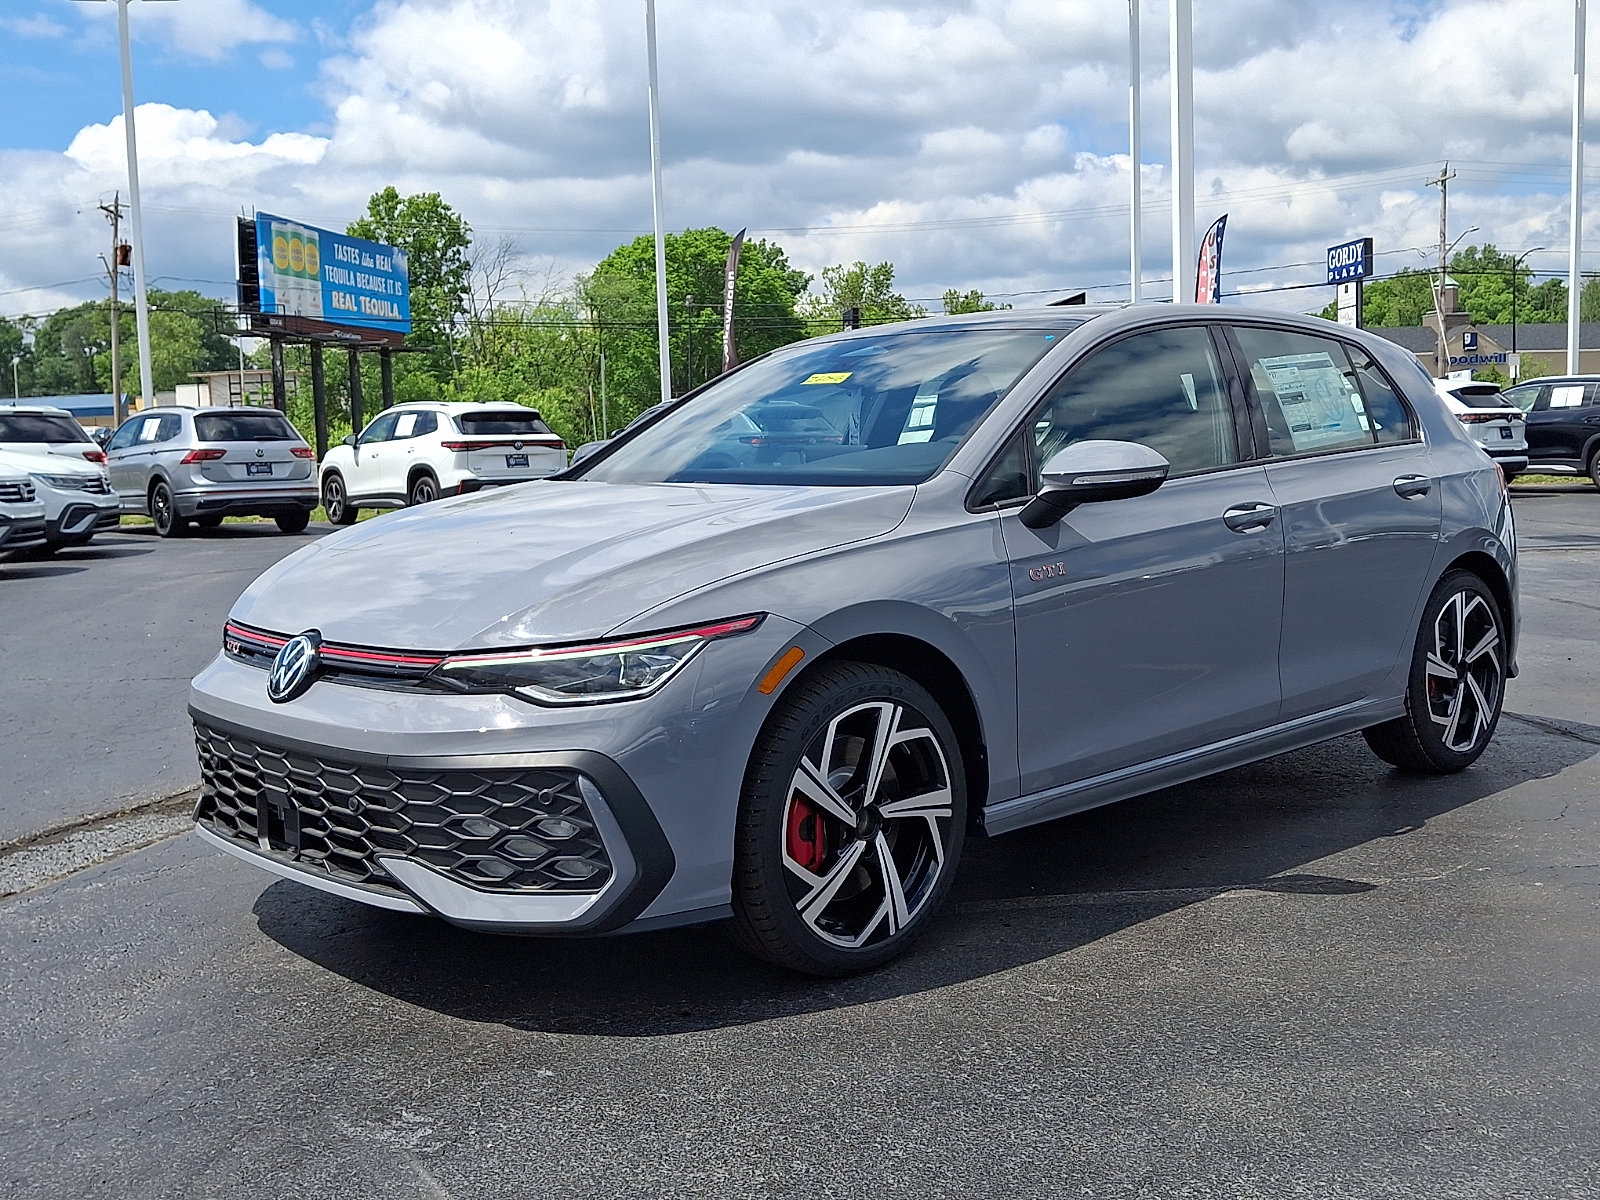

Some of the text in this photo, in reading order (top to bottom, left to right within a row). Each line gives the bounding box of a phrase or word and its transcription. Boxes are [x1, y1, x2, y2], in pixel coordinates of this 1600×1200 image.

[334, 243, 360, 265] TASTES
[361, 252, 375, 268] like
[376, 254, 392, 272] REAL
[1328, 242, 1364, 269] GORDY
[325, 265, 403, 296] TEQUILA BECAUSE IT IS
[1328, 264, 1364, 282] PLAZA
[332, 291, 402, 319] REAL TEQUILA.
[1029, 561, 1067, 582] GTI
